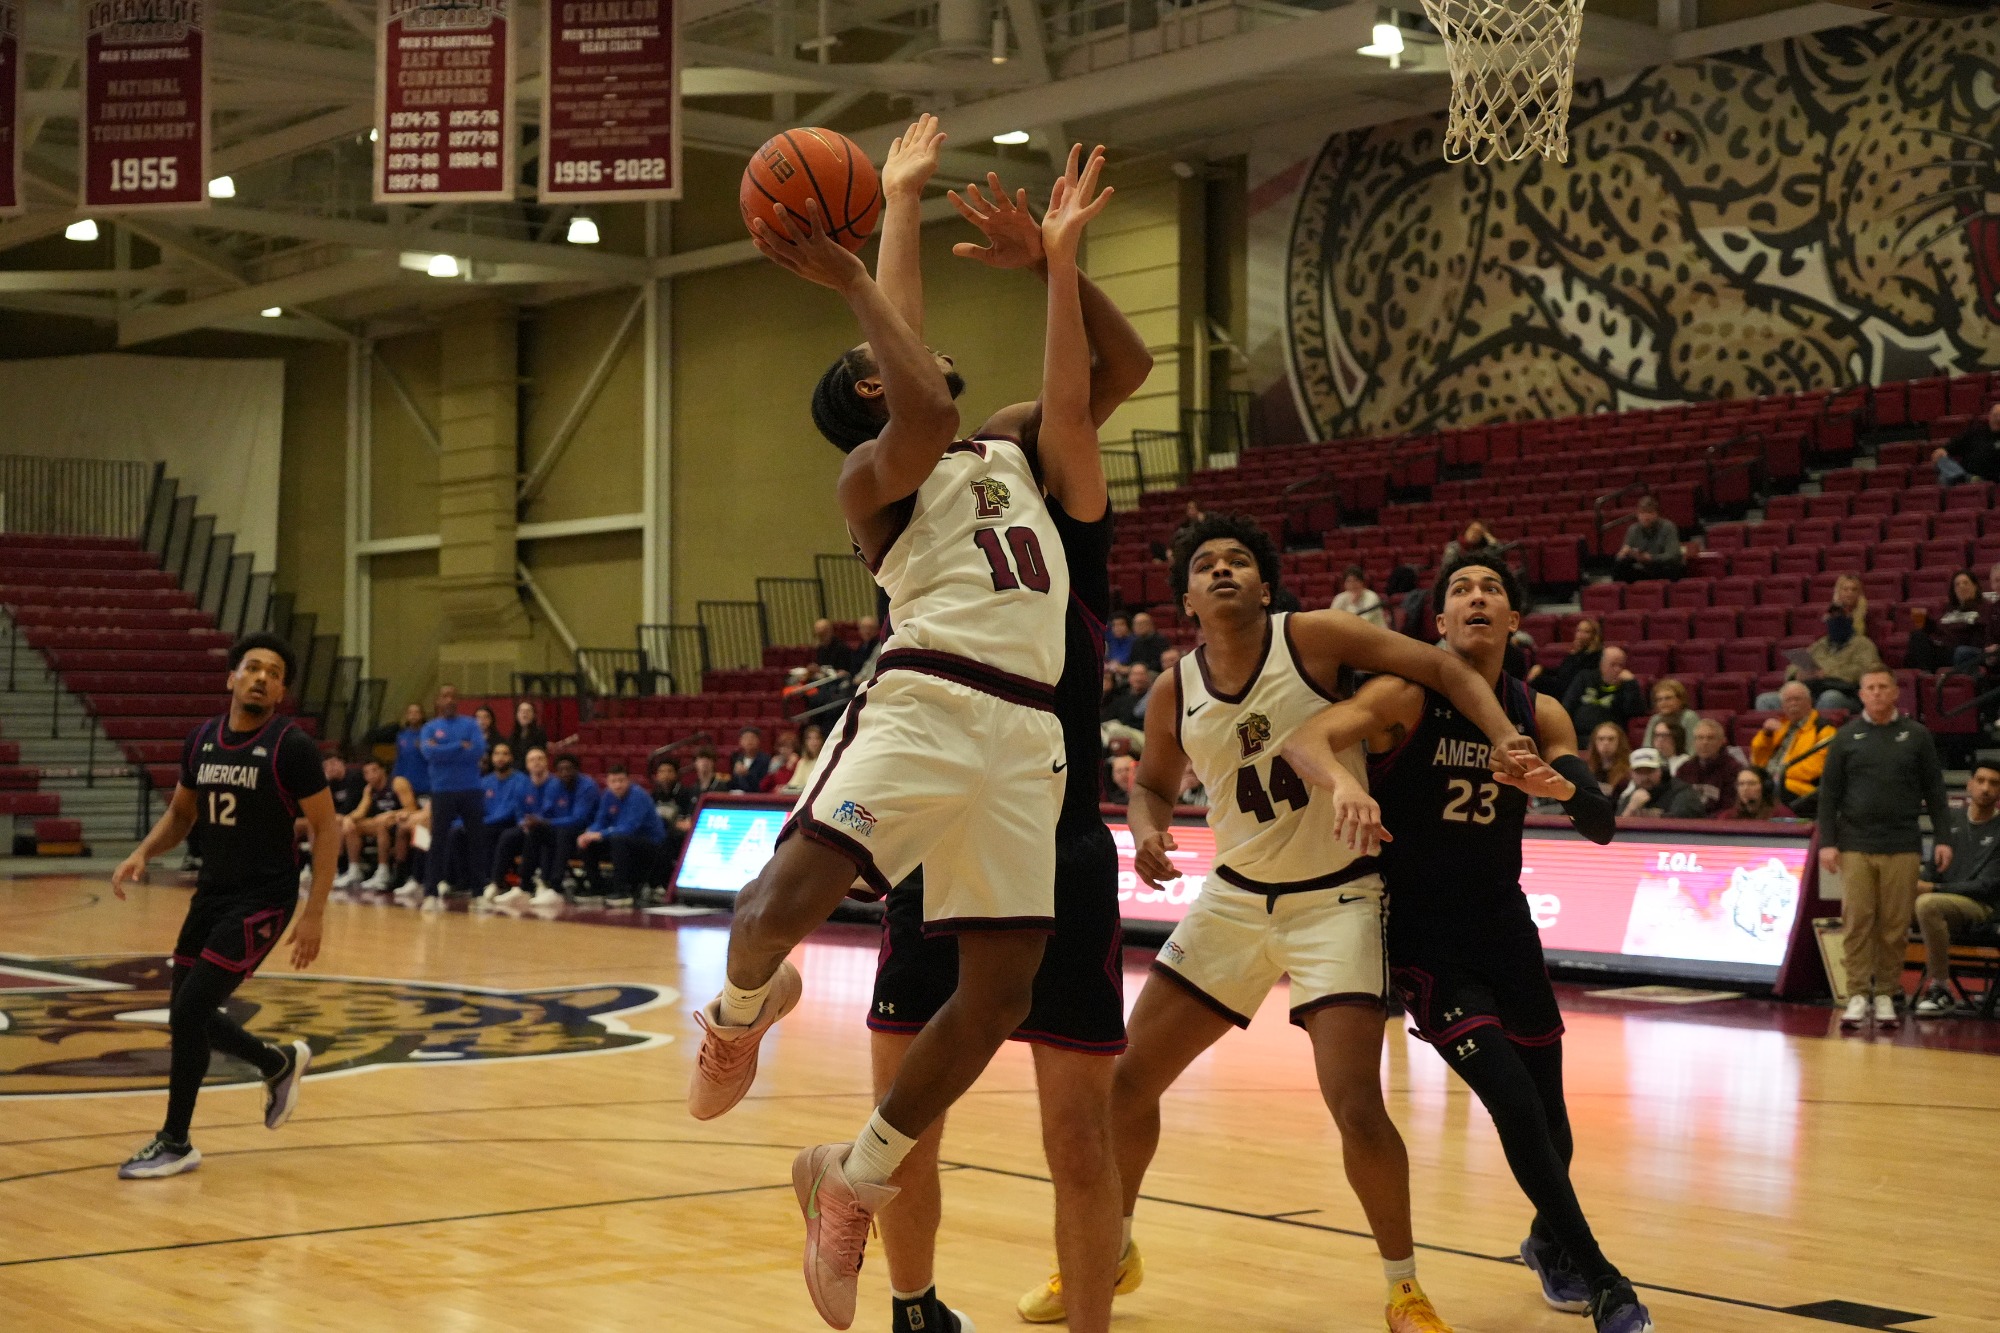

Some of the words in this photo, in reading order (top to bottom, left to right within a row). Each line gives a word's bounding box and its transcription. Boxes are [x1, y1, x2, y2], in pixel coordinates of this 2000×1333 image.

[109, 157, 178, 191] 1955
[554, 158, 666, 184] 1995-2022
[973, 526, 1051, 595] 10
[197, 763, 259, 790] AMERICAN
[1236, 755, 1309, 823] 44
[208, 791, 237, 826] 12
[1442, 779, 1499, 825] 23
